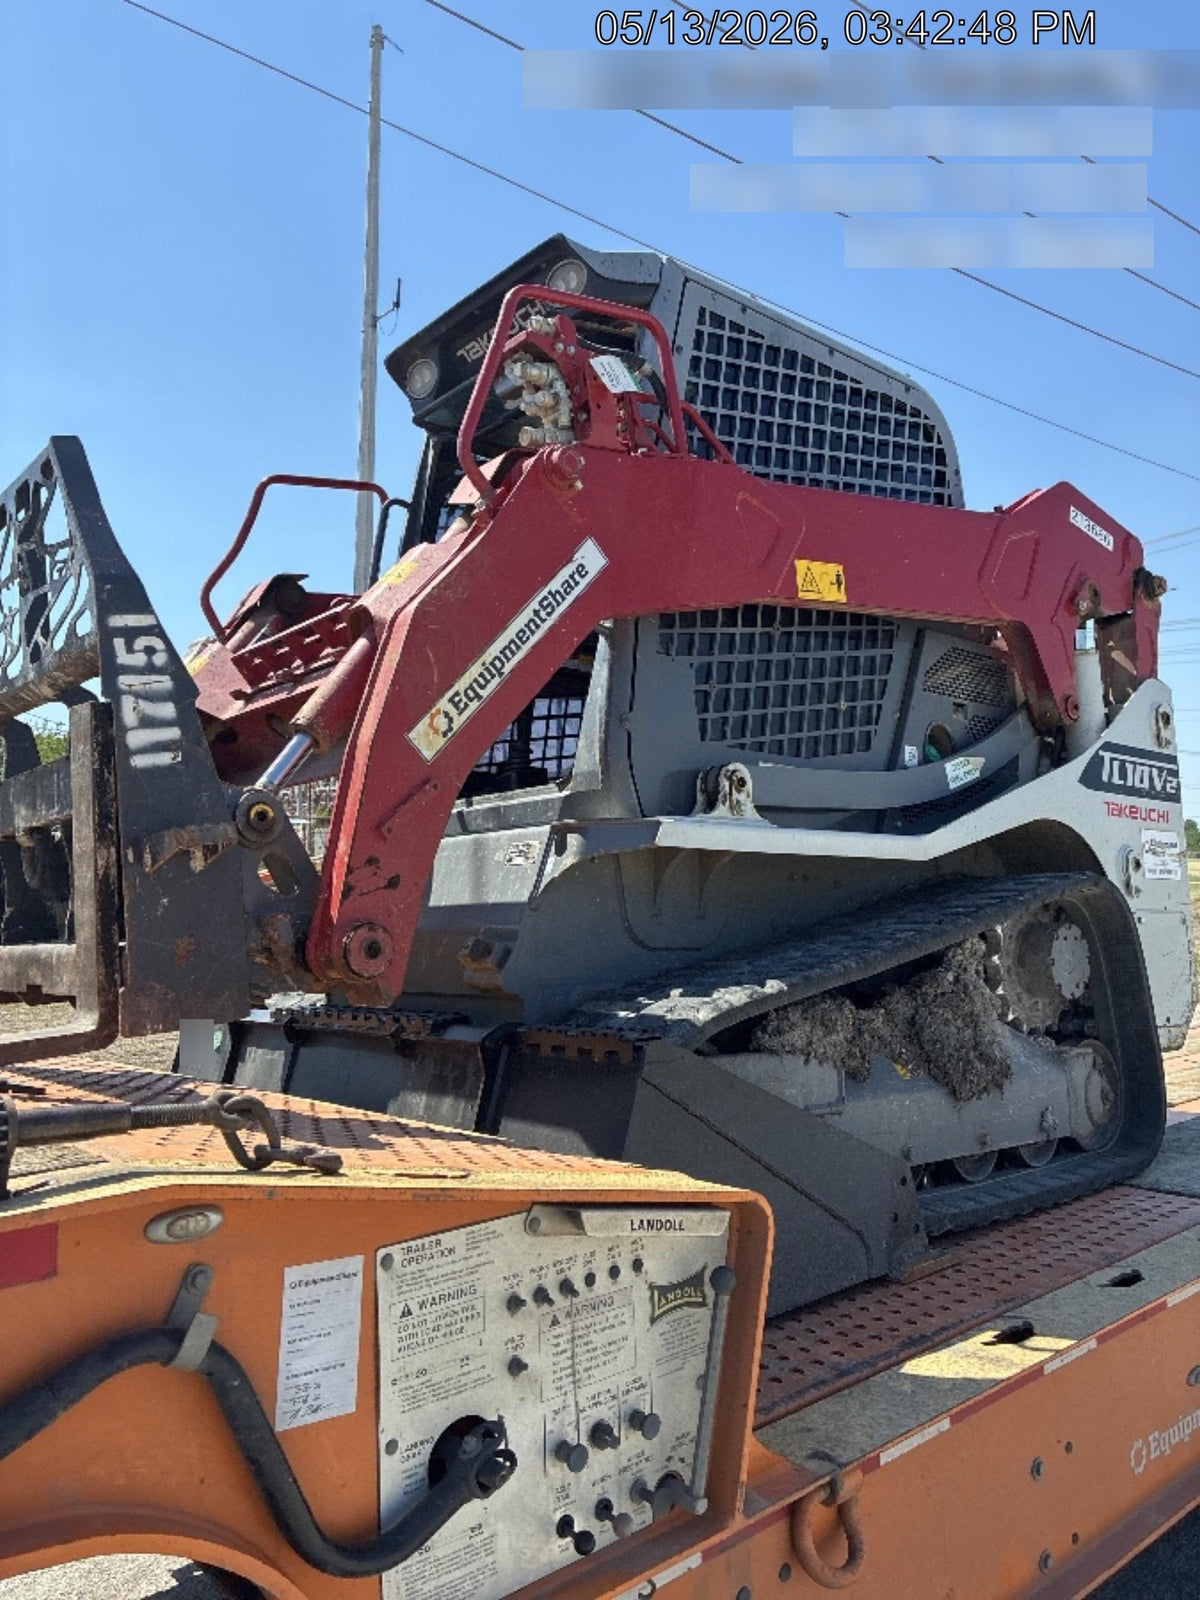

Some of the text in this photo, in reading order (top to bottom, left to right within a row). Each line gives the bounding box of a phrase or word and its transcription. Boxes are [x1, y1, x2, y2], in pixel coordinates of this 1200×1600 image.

[447, 562, 589, 716] EquipmentShare
[630, 1219, 685, 1232] LANDOLL
[401, 1238, 442, 1256] TRAILER
[401, 1246, 456, 1268] OPERATION
[417, 1284, 477, 1311] WARNING
[653, 1286, 704, 1318] LANDOLL
